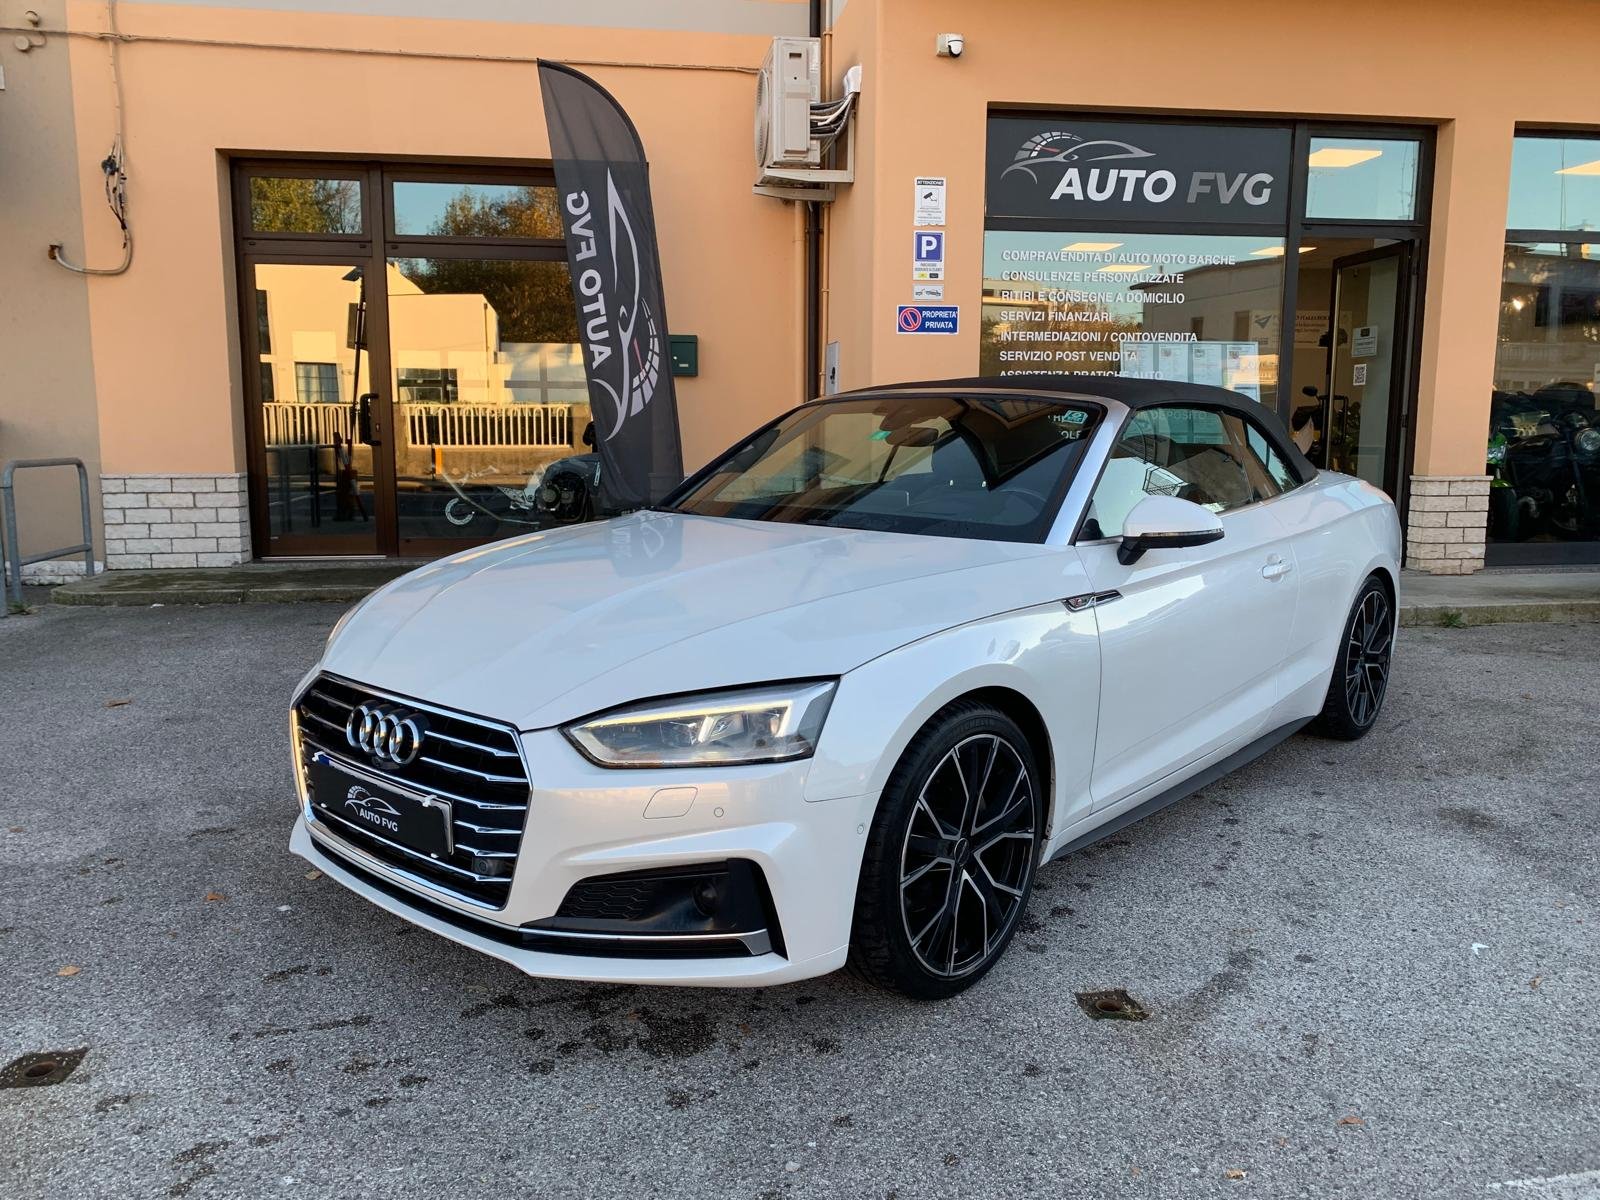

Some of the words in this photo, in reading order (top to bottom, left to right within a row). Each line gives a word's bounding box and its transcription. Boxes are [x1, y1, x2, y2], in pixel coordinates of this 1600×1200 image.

[1050, 168, 1177, 204] AUTO
[1187, 171, 1275, 206] FVG
[921, 235, 938, 258] P
[1002, 250, 1102, 264] COMPRAVENDITA
[1105, 253, 1117, 264] DI
[1120, 253, 1150, 265] AUTO
[1153, 253, 1187, 265] MOTO
[1189, 254, 1236, 266] BARCHE
[1001, 271, 1080, 283] CONSULENZE
[1083, 272, 1184, 284] PERSONALIZZATE
[1001, 290, 1034, 302] RITIRI
[1038, 291, 1046, 302] E
[1048, 291, 1113, 303] CONSEGNE
[1115, 292, 1124, 303] A
[1126, 292, 1185, 304] DOMICILIO
[1000, 310, 1045, 321] SERVIZI
[1048, 311, 1112, 323] FINANZIARI
[925, 321, 954, 329] PRIVATA
[1000, 331, 1101, 342] INTERMEDIAZIONI
[1110, 332, 1198, 343] CONTOVENDITA
[999, 351, 1053, 361] SERVIZIO
[1055, 351, 1086, 361] POST
[1089, 351, 1138, 362] VENDITA
[359, 808, 380, 824] AUTO
[381, 817, 398, 832] FVG
